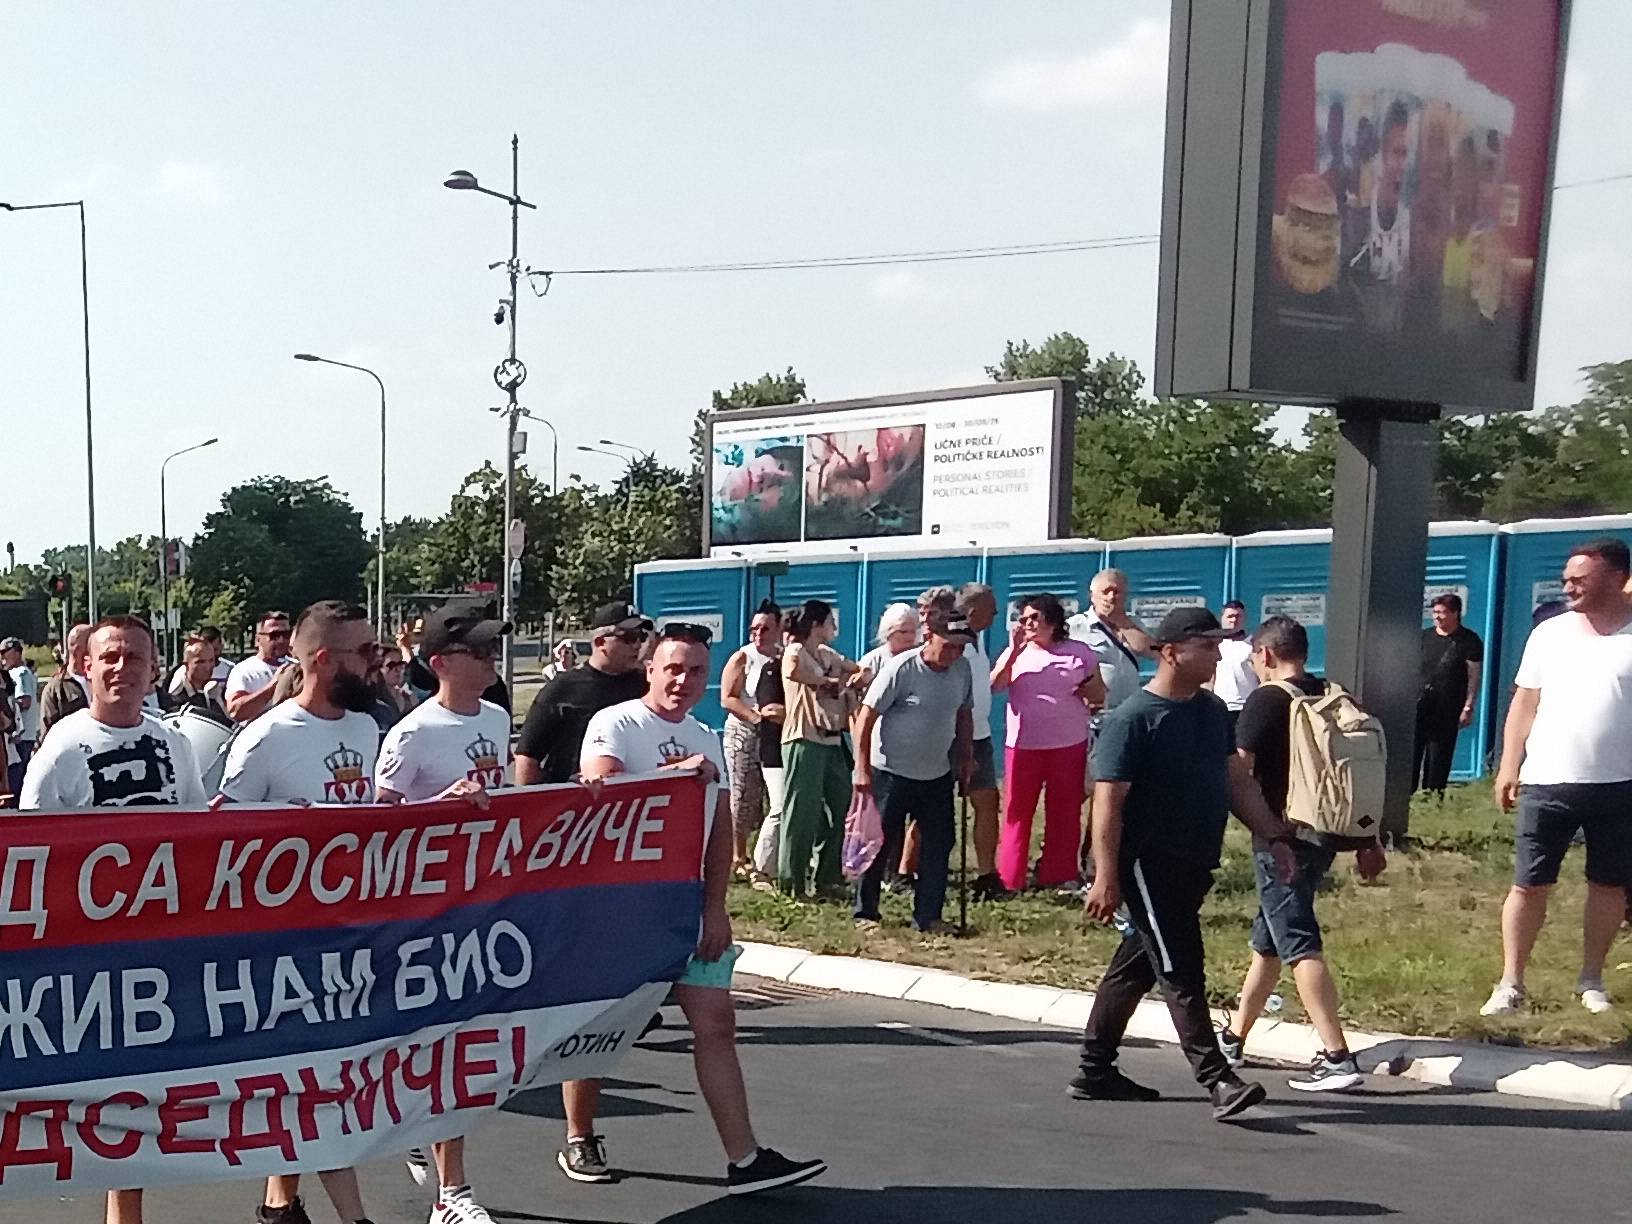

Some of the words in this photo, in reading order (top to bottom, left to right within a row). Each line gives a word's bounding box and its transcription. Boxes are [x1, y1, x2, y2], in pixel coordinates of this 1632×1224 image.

[986, 446, 1045, 460] REALNOSTI
[933, 473, 982, 484] PERSONAL
[984, 468, 1026, 481] STORIES
[933, 487, 979, 498] POLITICAL
[982, 482, 1029, 495] REALITIES
[77, 841, 181, 921] СА
[202, 947, 377, 1038] НАМ
[394, 919, 533, 1012] БИО
